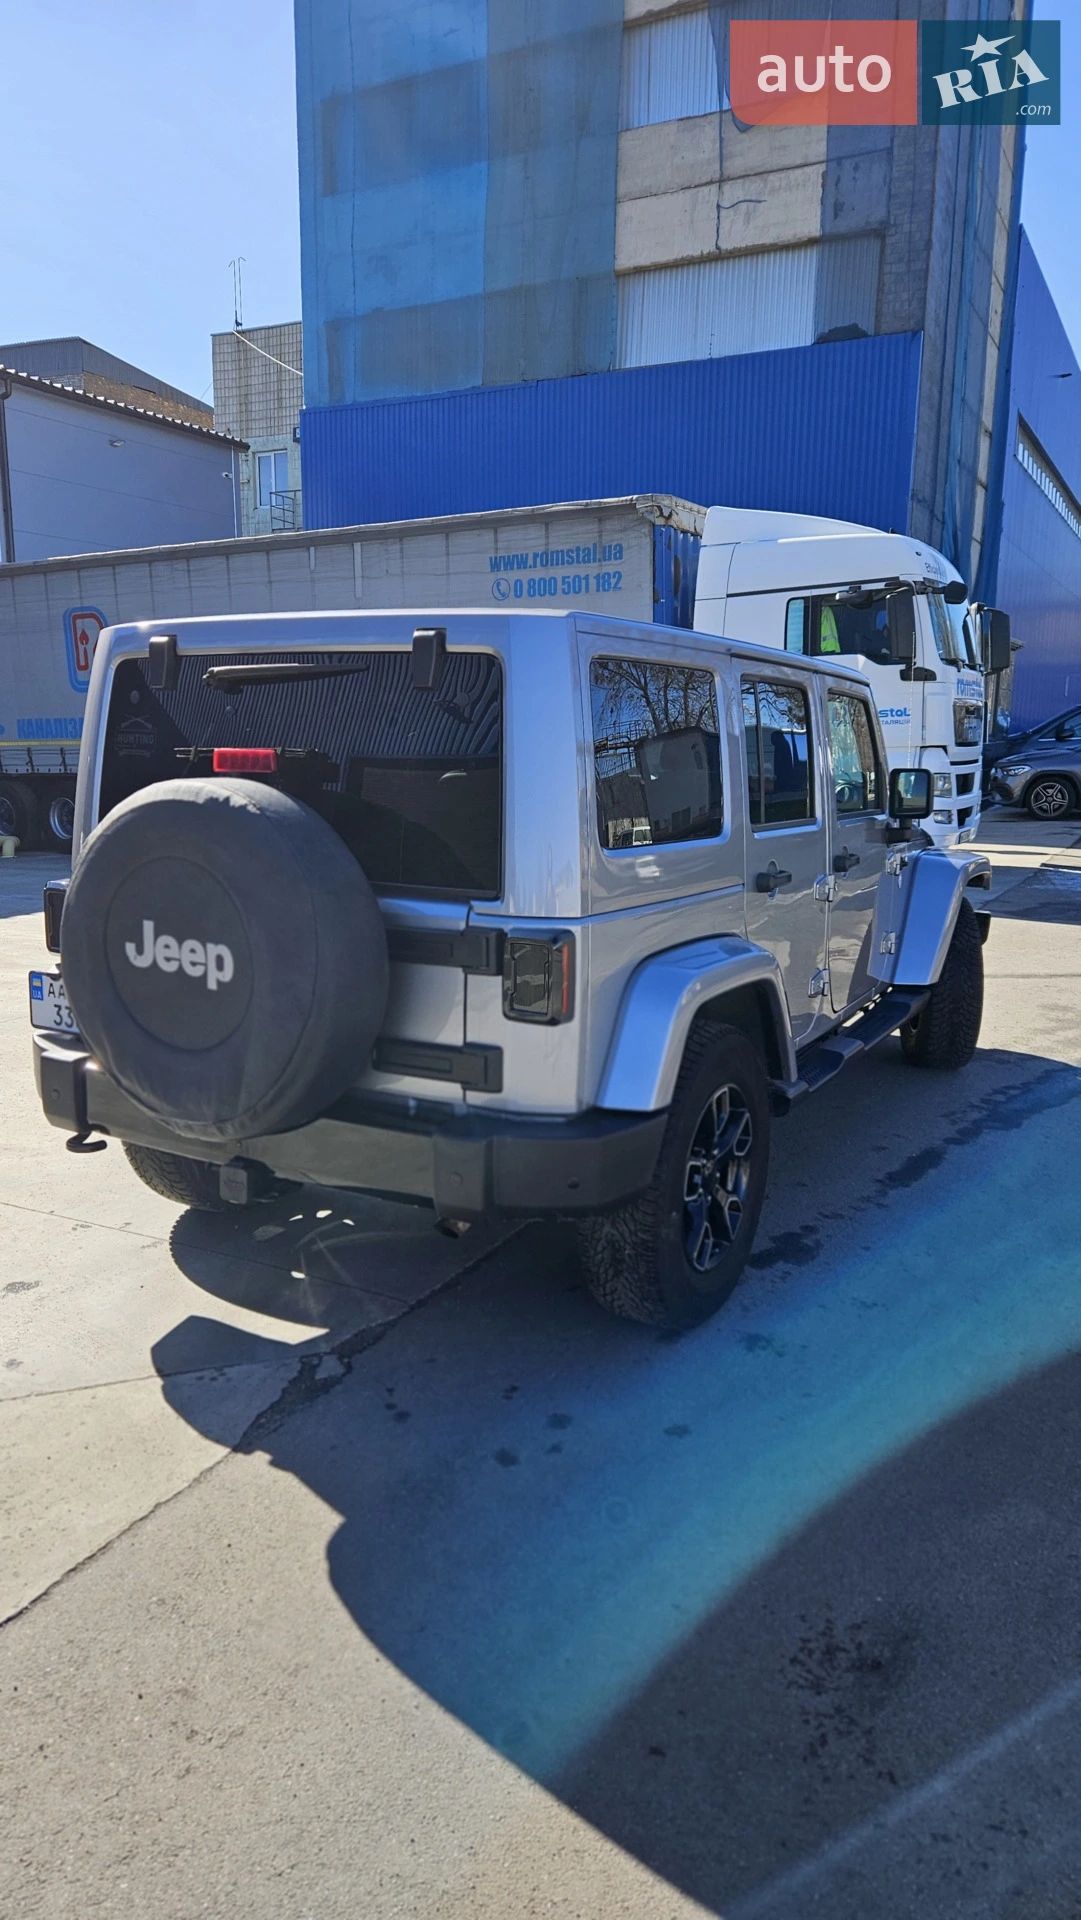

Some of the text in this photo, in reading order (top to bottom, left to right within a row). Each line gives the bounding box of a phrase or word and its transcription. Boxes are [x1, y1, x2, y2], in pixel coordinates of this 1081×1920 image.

[488, 543, 624, 573] www.romstal.ua
[513, 570, 623, 599] 0 800 501 182
[124, 919, 235, 991] Jeep
[32, 990, 42, 999] UA
